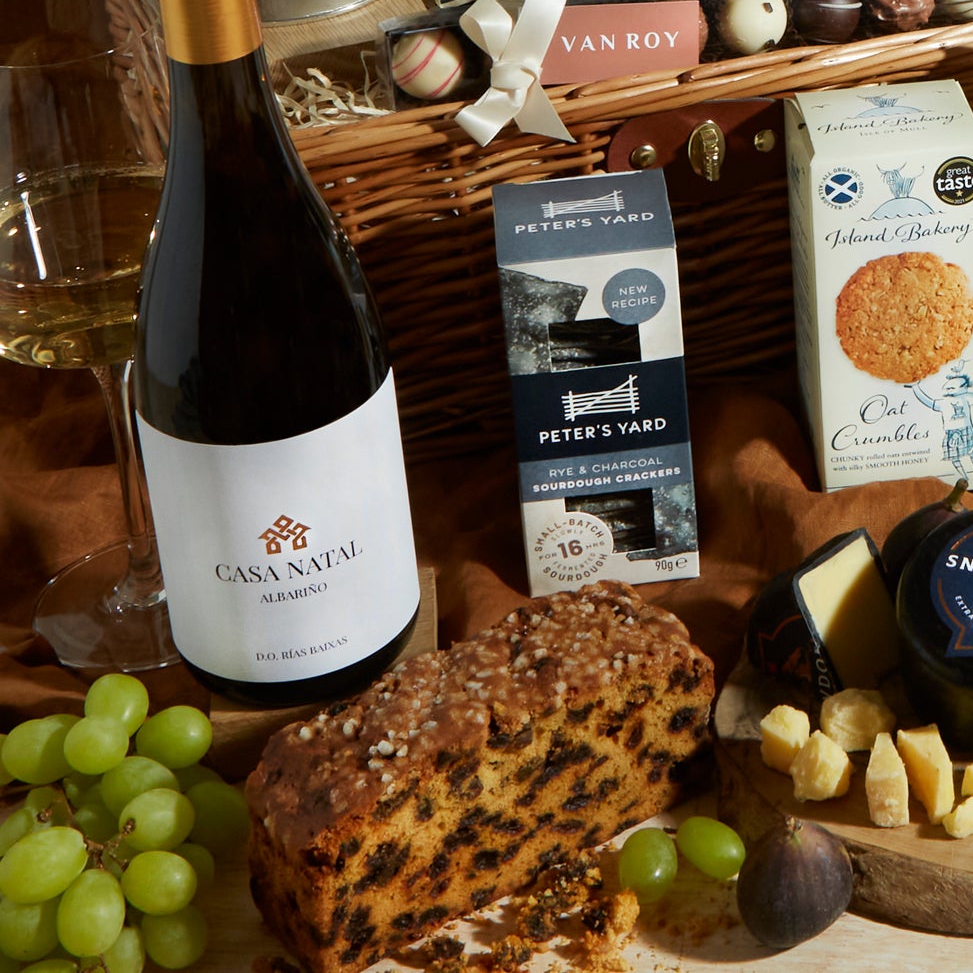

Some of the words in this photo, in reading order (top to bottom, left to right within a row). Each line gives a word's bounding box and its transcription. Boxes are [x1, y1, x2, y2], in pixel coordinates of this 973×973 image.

[561, 34, 615, 52] VAN
[627, 31, 679, 50] ROY
[817, 119, 880, 134] Island
[883, 112, 964, 127] Bakery
[946, 166, 971, 178] great
[515, 217, 593, 234] PETER'S
[600, 212, 655, 225] YARD
[825, 227, 893, 250] Island
[619, 285, 648, 296] NEW
[611, 296, 657, 309] RECIPE
[859, 394, 909, 425] Oat
[539, 424, 612, 444] PETER'S
[617, 418, 667, 435] YARD
[831, 423, 930, 452] Crumbles
[549, 467, 573, 478] RYE
[579, 465, 587, 474] &
[592, 457, 663, 473] CHARCOAL
[830, 455, 864, 464] CHUNKY
[866, 452, 885, 461] rolled
[833, 464, 847, 472] with
[849, 463, 864, 473] silky
[865, 461, 901, 470] SMOOTH
[901, 458, 929, 467] HONEY
[533, 477, 611, 493] SOURDOUGH
[615, 467, 681, 483] CRACKERS
[534, 518, 605, 552] SMALL-BATCH
[557, 540, 583, 559] 16
[215, 563, 280, 584] CASA
[286, 539, 363, 580] NATAL
[543, 553, 608, 582] SOURDOUGH
[655, 560, 673, 572] 90g
[260, 582, 328, 604] ALBARIÑO
[954, 595, 973, 620] EXTRA
[281, 647, 307, 660] RÍAS
[310, 636, 348, 656] BAIXAS
